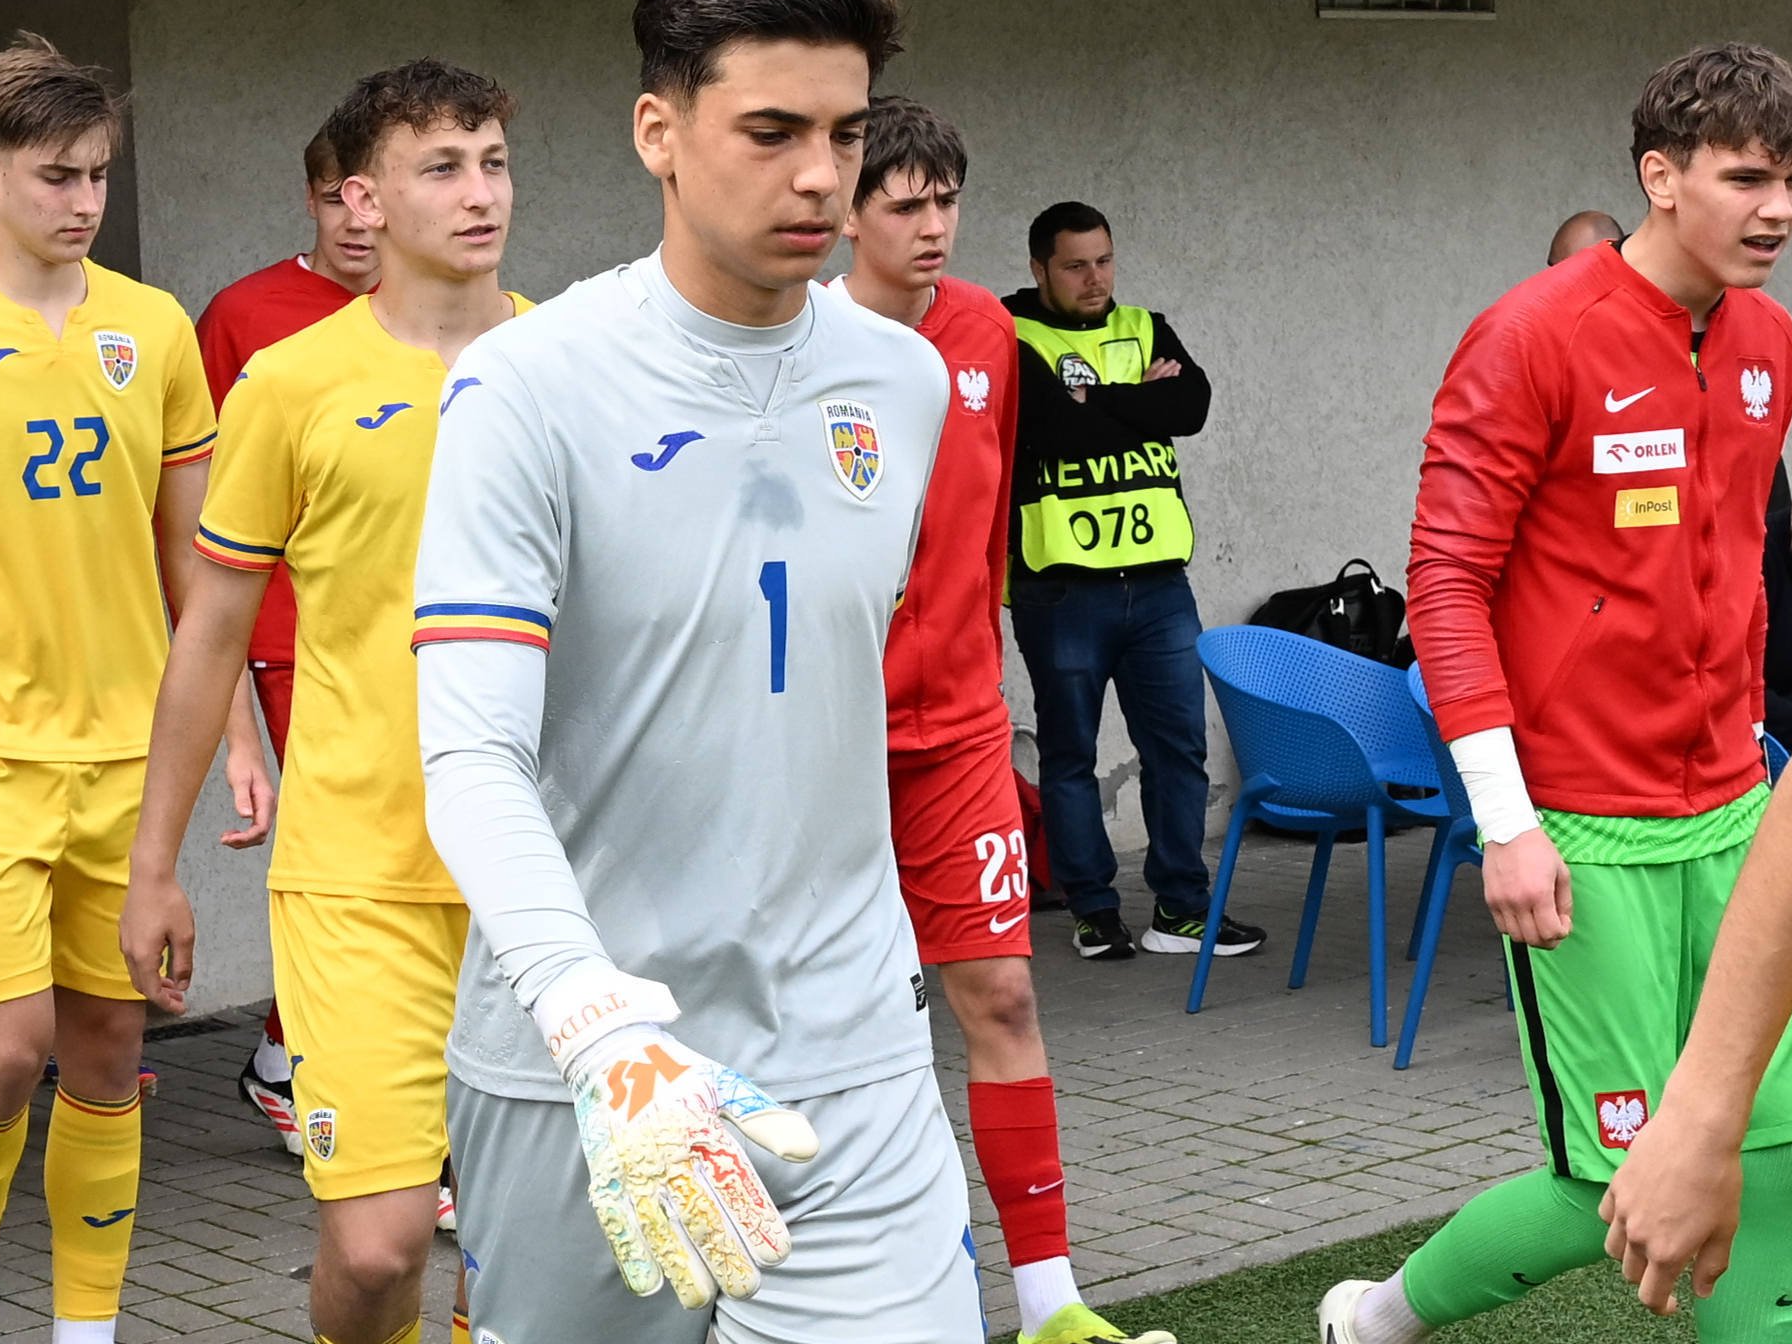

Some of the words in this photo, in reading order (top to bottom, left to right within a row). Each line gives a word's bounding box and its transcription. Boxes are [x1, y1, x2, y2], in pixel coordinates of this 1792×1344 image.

[22, 416, 110, 500] 22
[1634, 443, 1677, 458] ORLEN
[1068, 503, 1154, 551] 078
[1635, 500, 1672, 514] InPost
[758, 561, 787, 694] 1
[974, 829, 1028, 903] 23
